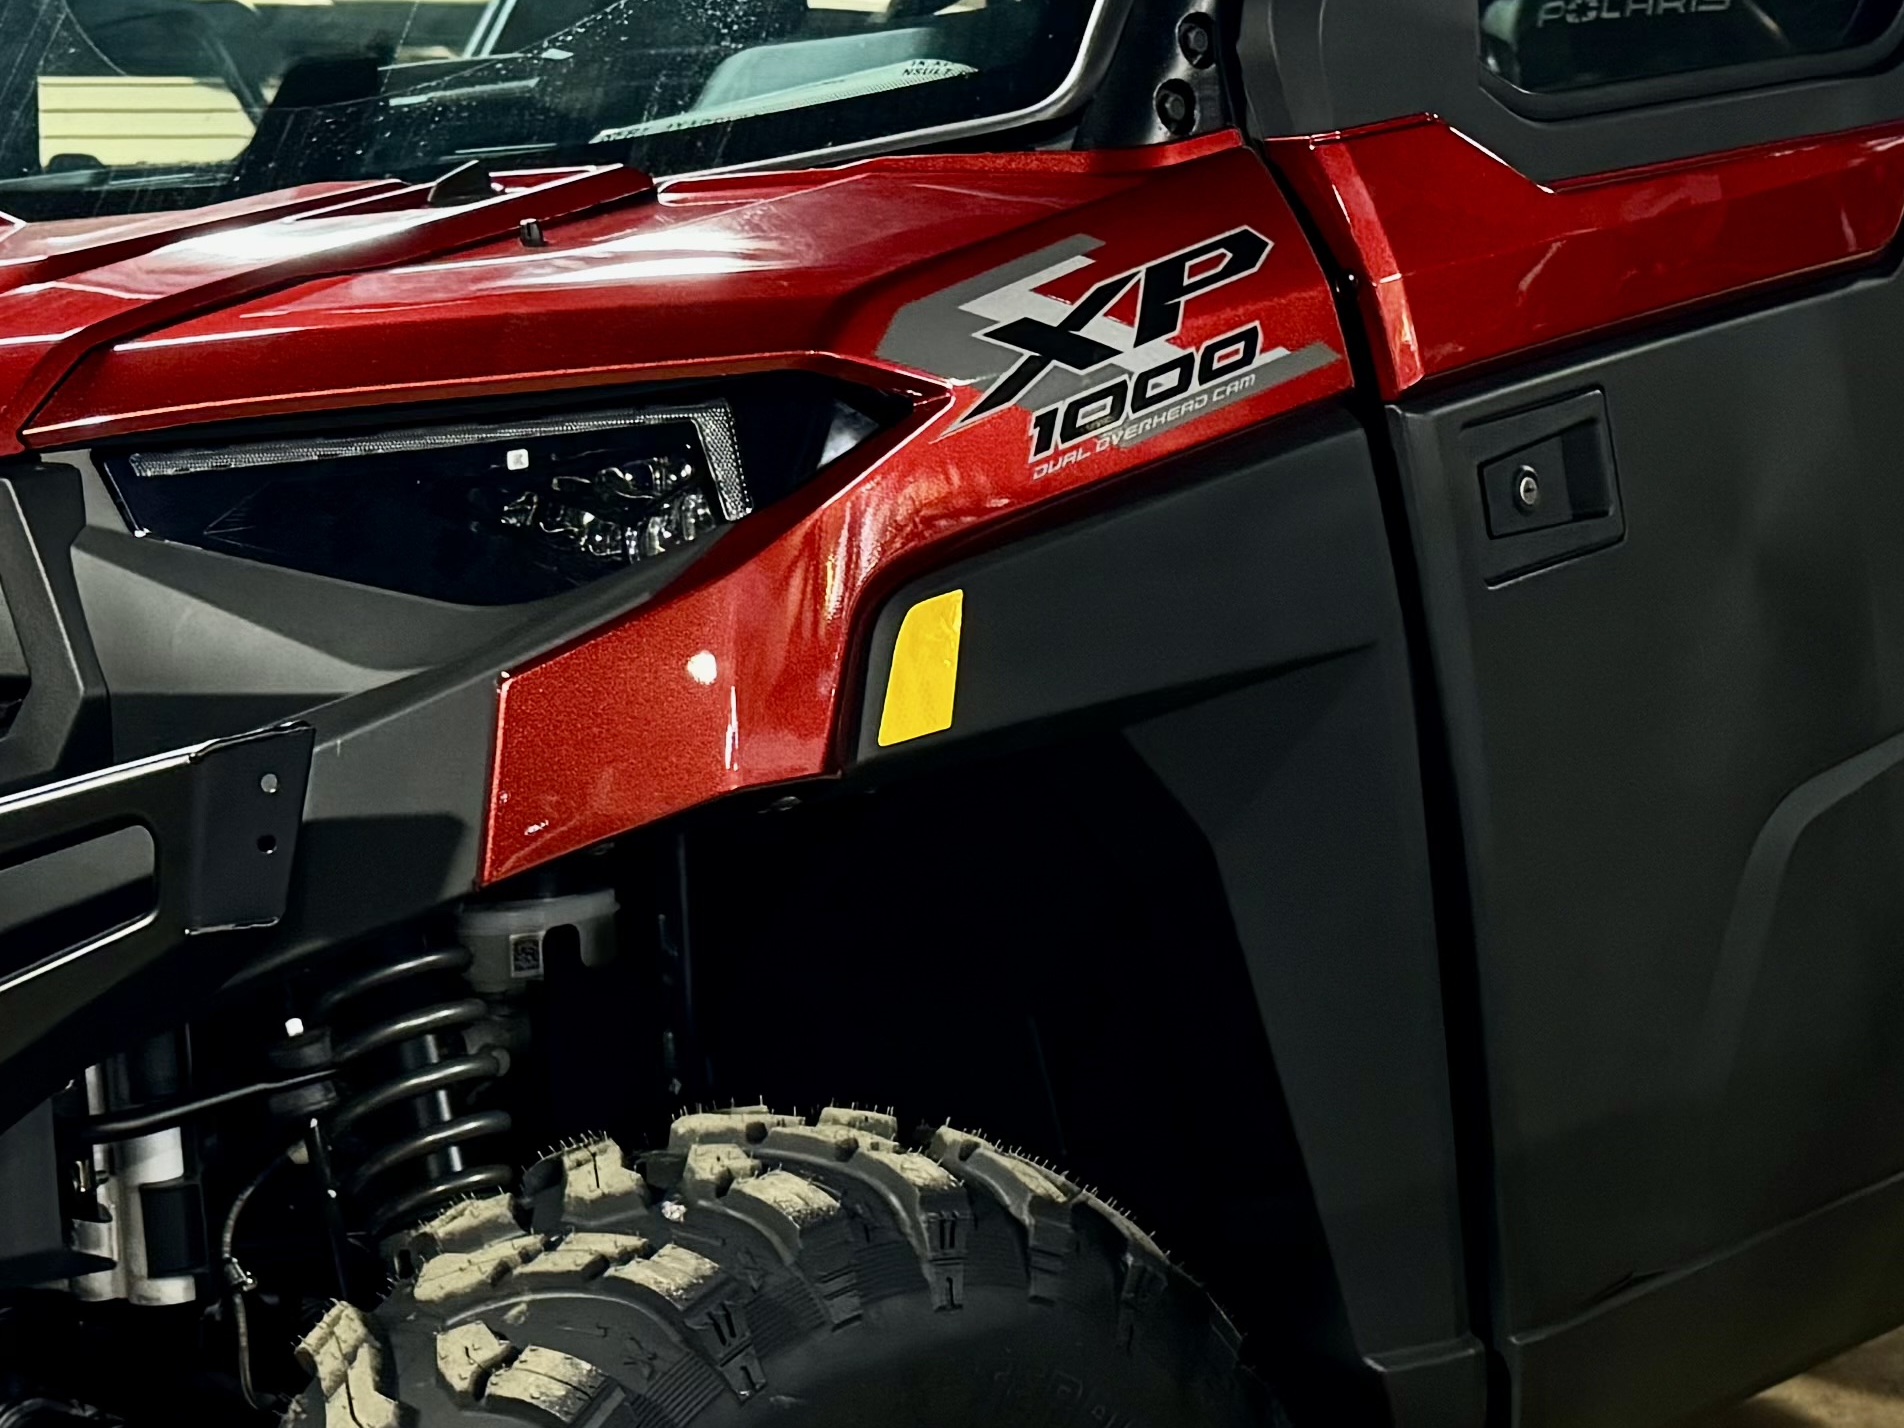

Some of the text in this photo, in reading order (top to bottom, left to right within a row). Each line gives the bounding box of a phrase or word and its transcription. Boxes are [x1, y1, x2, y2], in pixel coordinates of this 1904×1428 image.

[930, 225, 1275, 444] XP
[1028, 320, 1264, 464] 1000
[1032, 373, 1256, 480] DUAL OVERHEAD CAM
